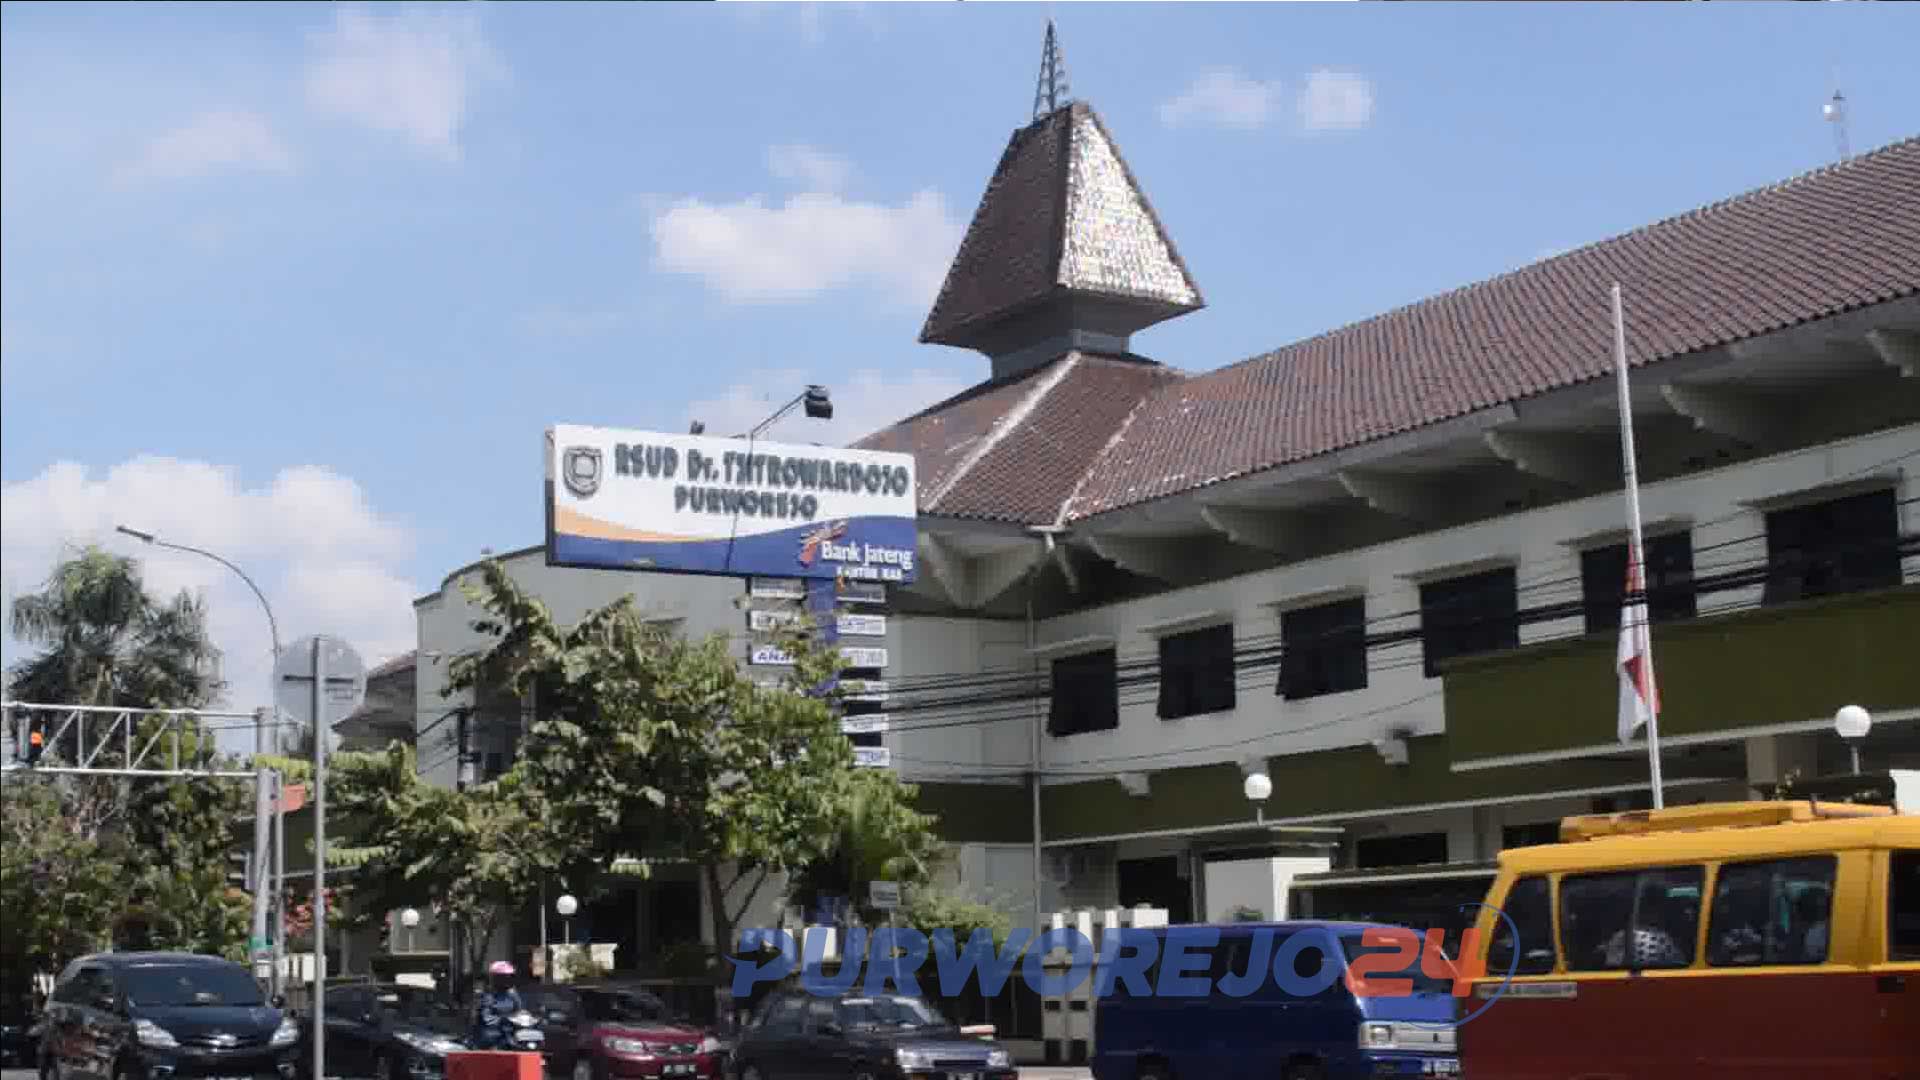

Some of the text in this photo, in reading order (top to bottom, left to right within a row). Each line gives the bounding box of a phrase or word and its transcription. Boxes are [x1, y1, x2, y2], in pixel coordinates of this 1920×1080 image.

[615, 443, 678, 477] RSUD
[687, 448, 719, 481] Dr.
[674, 485, 818, 521] PURWOREJO
[822, 540, 914, 570] Bank Jateng
